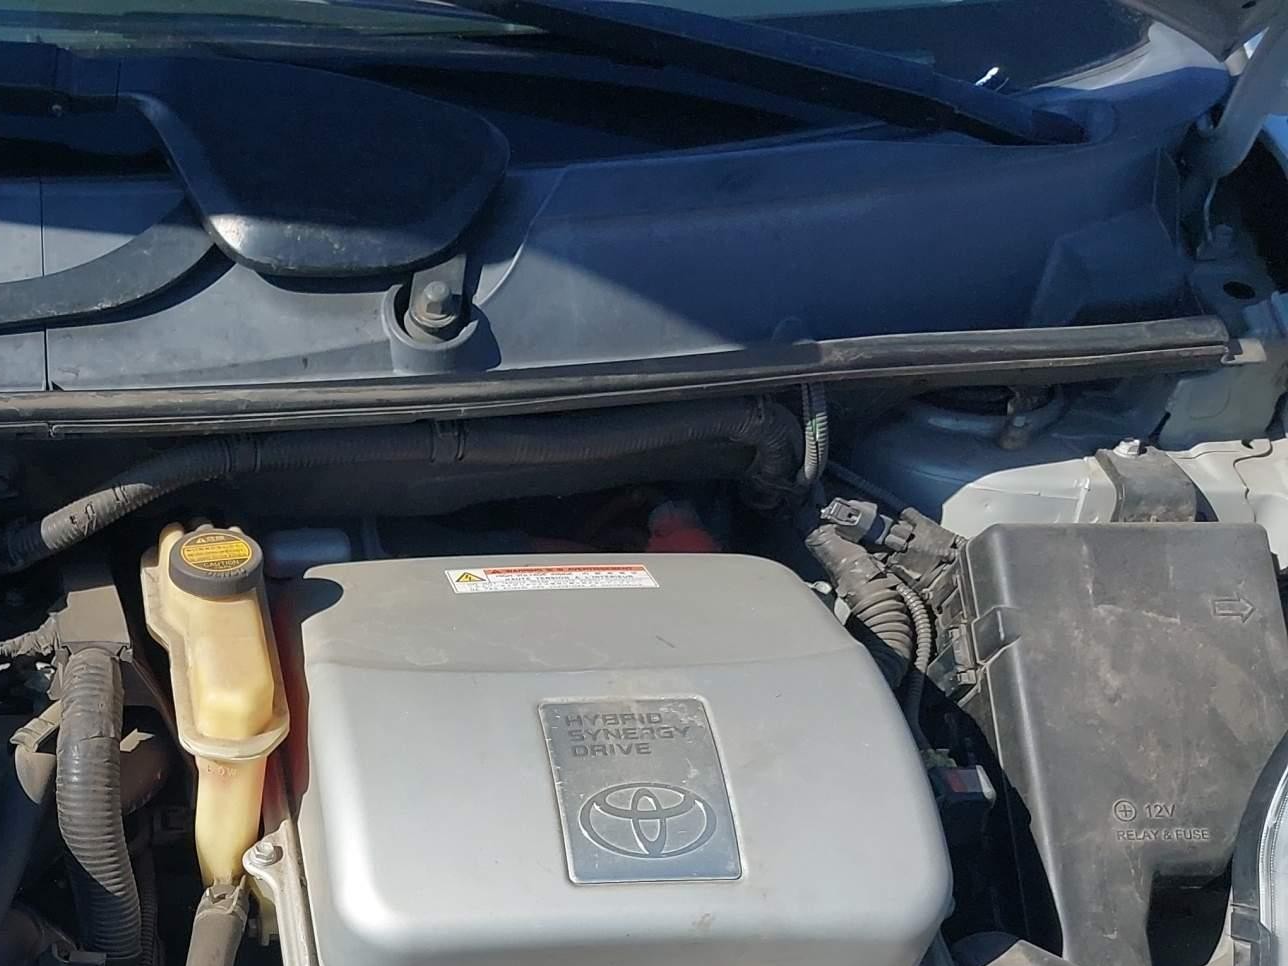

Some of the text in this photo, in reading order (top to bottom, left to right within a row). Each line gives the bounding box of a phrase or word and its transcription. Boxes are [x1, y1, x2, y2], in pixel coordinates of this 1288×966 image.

[565, 713, 662, 727] HYBRID
[567, 727, 690, 742] SYNERGY
[572, 742, 652, 757] DRIVE
[1145, 804, 1175, 818] 12V
[1116, 829, 1209, 840] RELAY & FUSE
